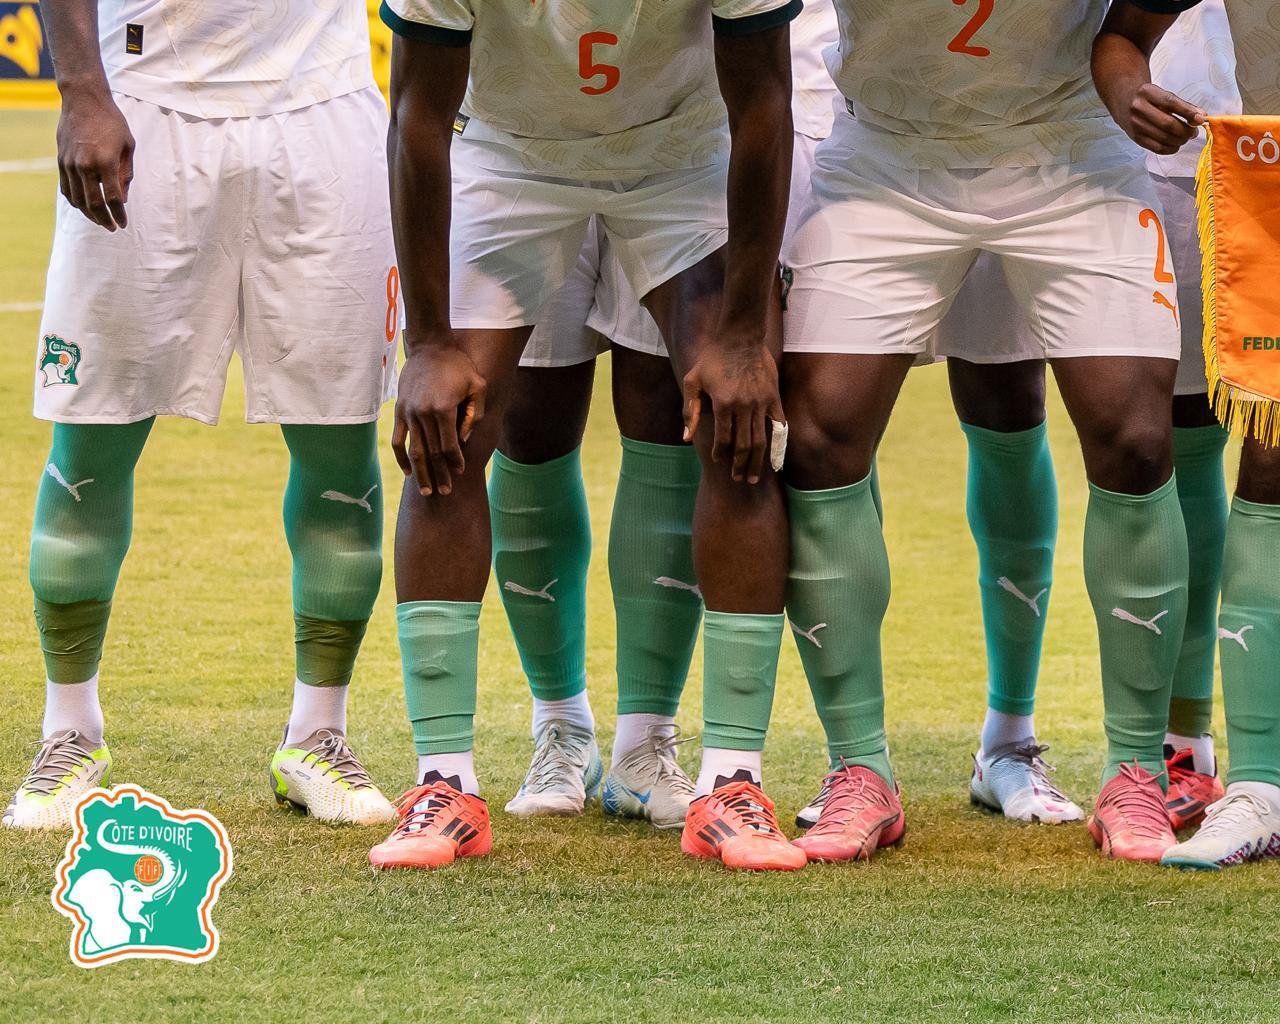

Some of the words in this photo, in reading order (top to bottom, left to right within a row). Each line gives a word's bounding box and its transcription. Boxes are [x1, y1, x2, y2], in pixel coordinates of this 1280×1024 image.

[578, 31, 621, 96] 5
[1138, 208, 1174, 284] 2
[385, 266, 399, 342] 8
